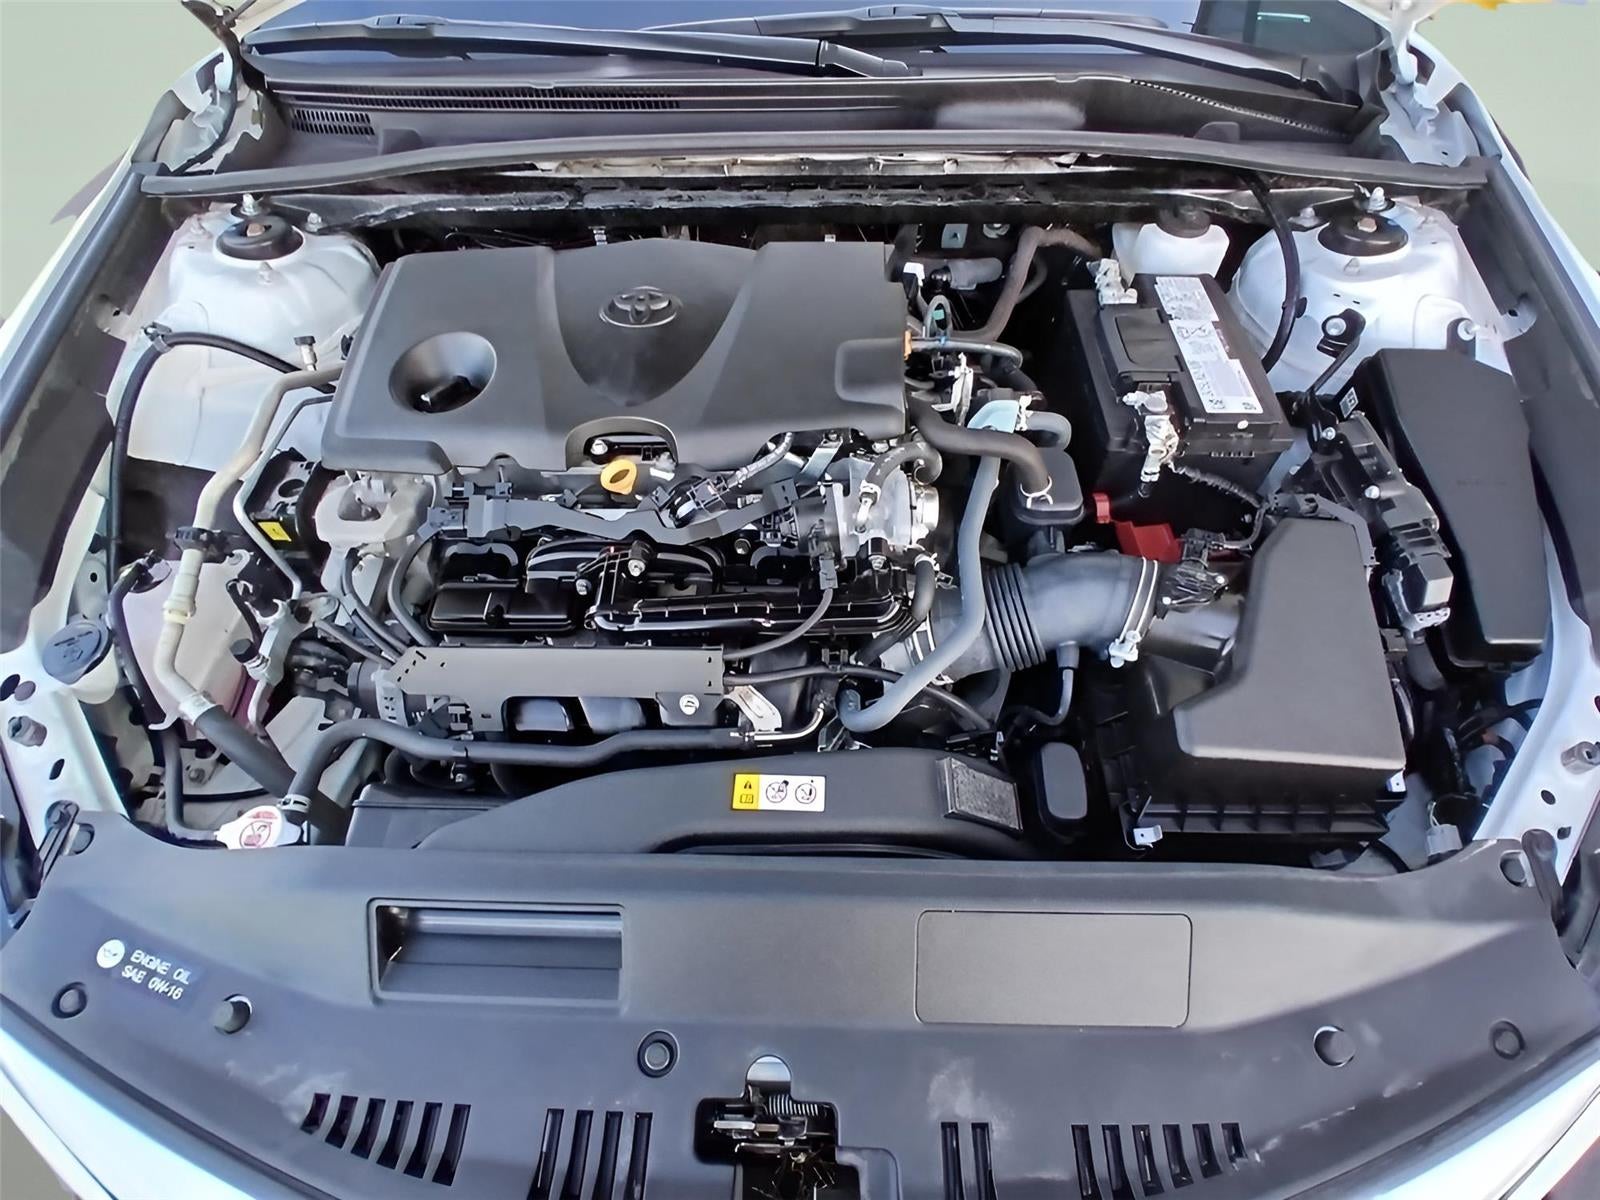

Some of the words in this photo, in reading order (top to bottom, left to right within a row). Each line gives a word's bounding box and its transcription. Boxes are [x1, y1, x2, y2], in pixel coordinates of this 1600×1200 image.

[121, 965, 147, 983] SAE
[130, 949, 171, 975] ENGINE
[173, 968, 192, 985] OIL
